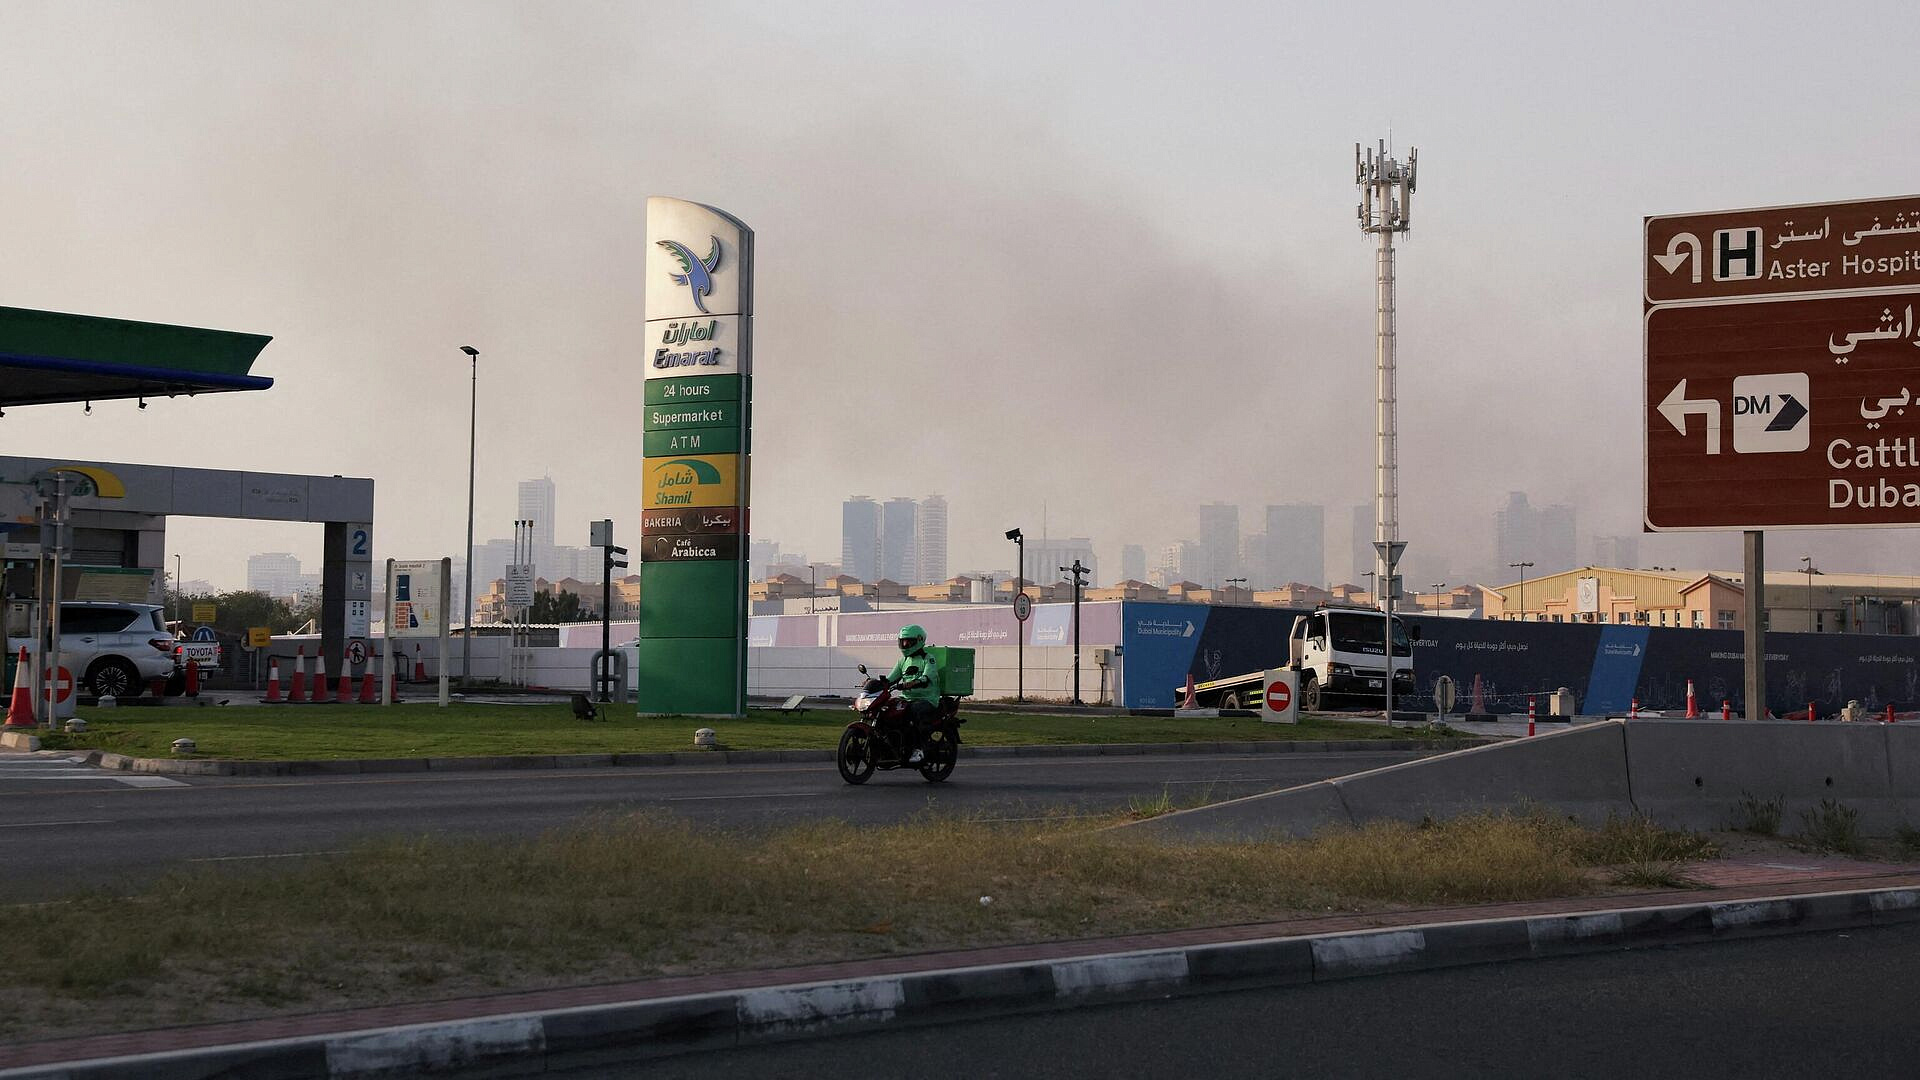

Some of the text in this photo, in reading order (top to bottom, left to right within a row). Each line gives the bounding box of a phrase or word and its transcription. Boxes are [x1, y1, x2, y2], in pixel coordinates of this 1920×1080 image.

[1770, 216, 1830, 249] استر
[1768, 259, 1831, 280] Aster
[653, 347, 720, 369] Emarat
[664, 384, 710, 397] 24 hours
[1734, 394, 1771, 415] DM
[653, 409, 723, 426] Supermarket
[1826, 437, 1920, 469] Cattl
[658, 468, 693, 489] شامل
[655, 491, 693, 505] Shamil
[1829, 477, 1920, 509] Duba
[644, 517, 682, 528] BAKERIA
[702, 514, 731, 528] بيكريا
[352, 530, 367, 555] 2
[671, 546, 716, 558] Arabicca
[186, 647, 213, 656] TOYOTA
